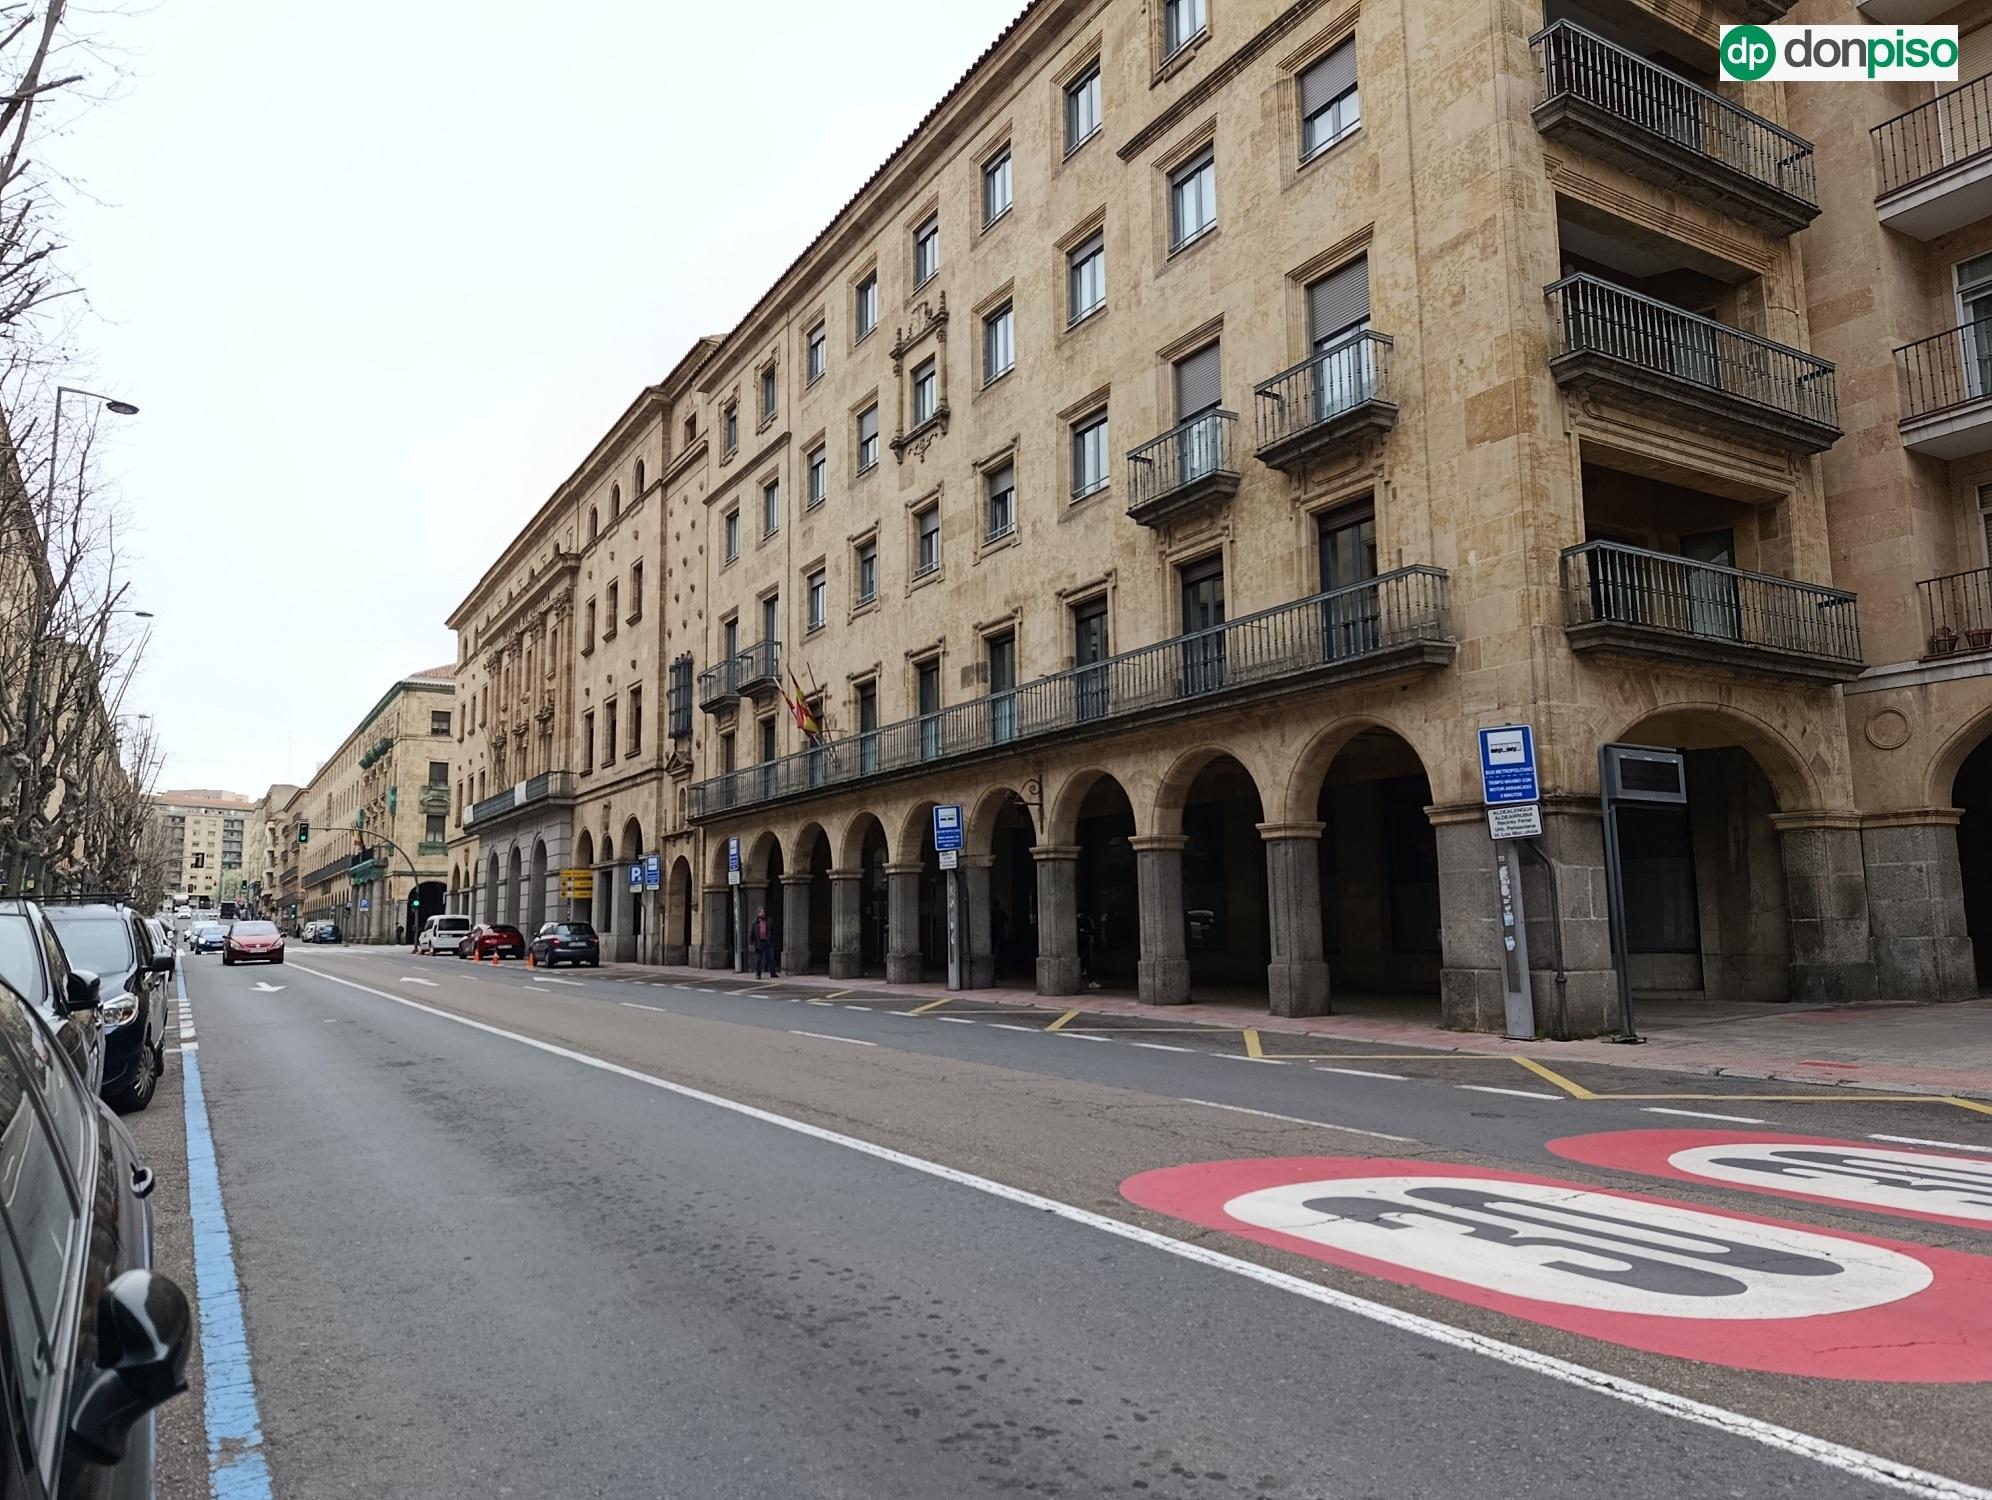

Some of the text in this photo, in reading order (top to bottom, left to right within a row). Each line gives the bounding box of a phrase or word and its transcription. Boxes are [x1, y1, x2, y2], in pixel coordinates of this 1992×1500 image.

[1493, 807, 1533, 816] ALDEALENGUA
[631, 867, 641, 882] P
[1300, 1186, 1846, 1298] 30
